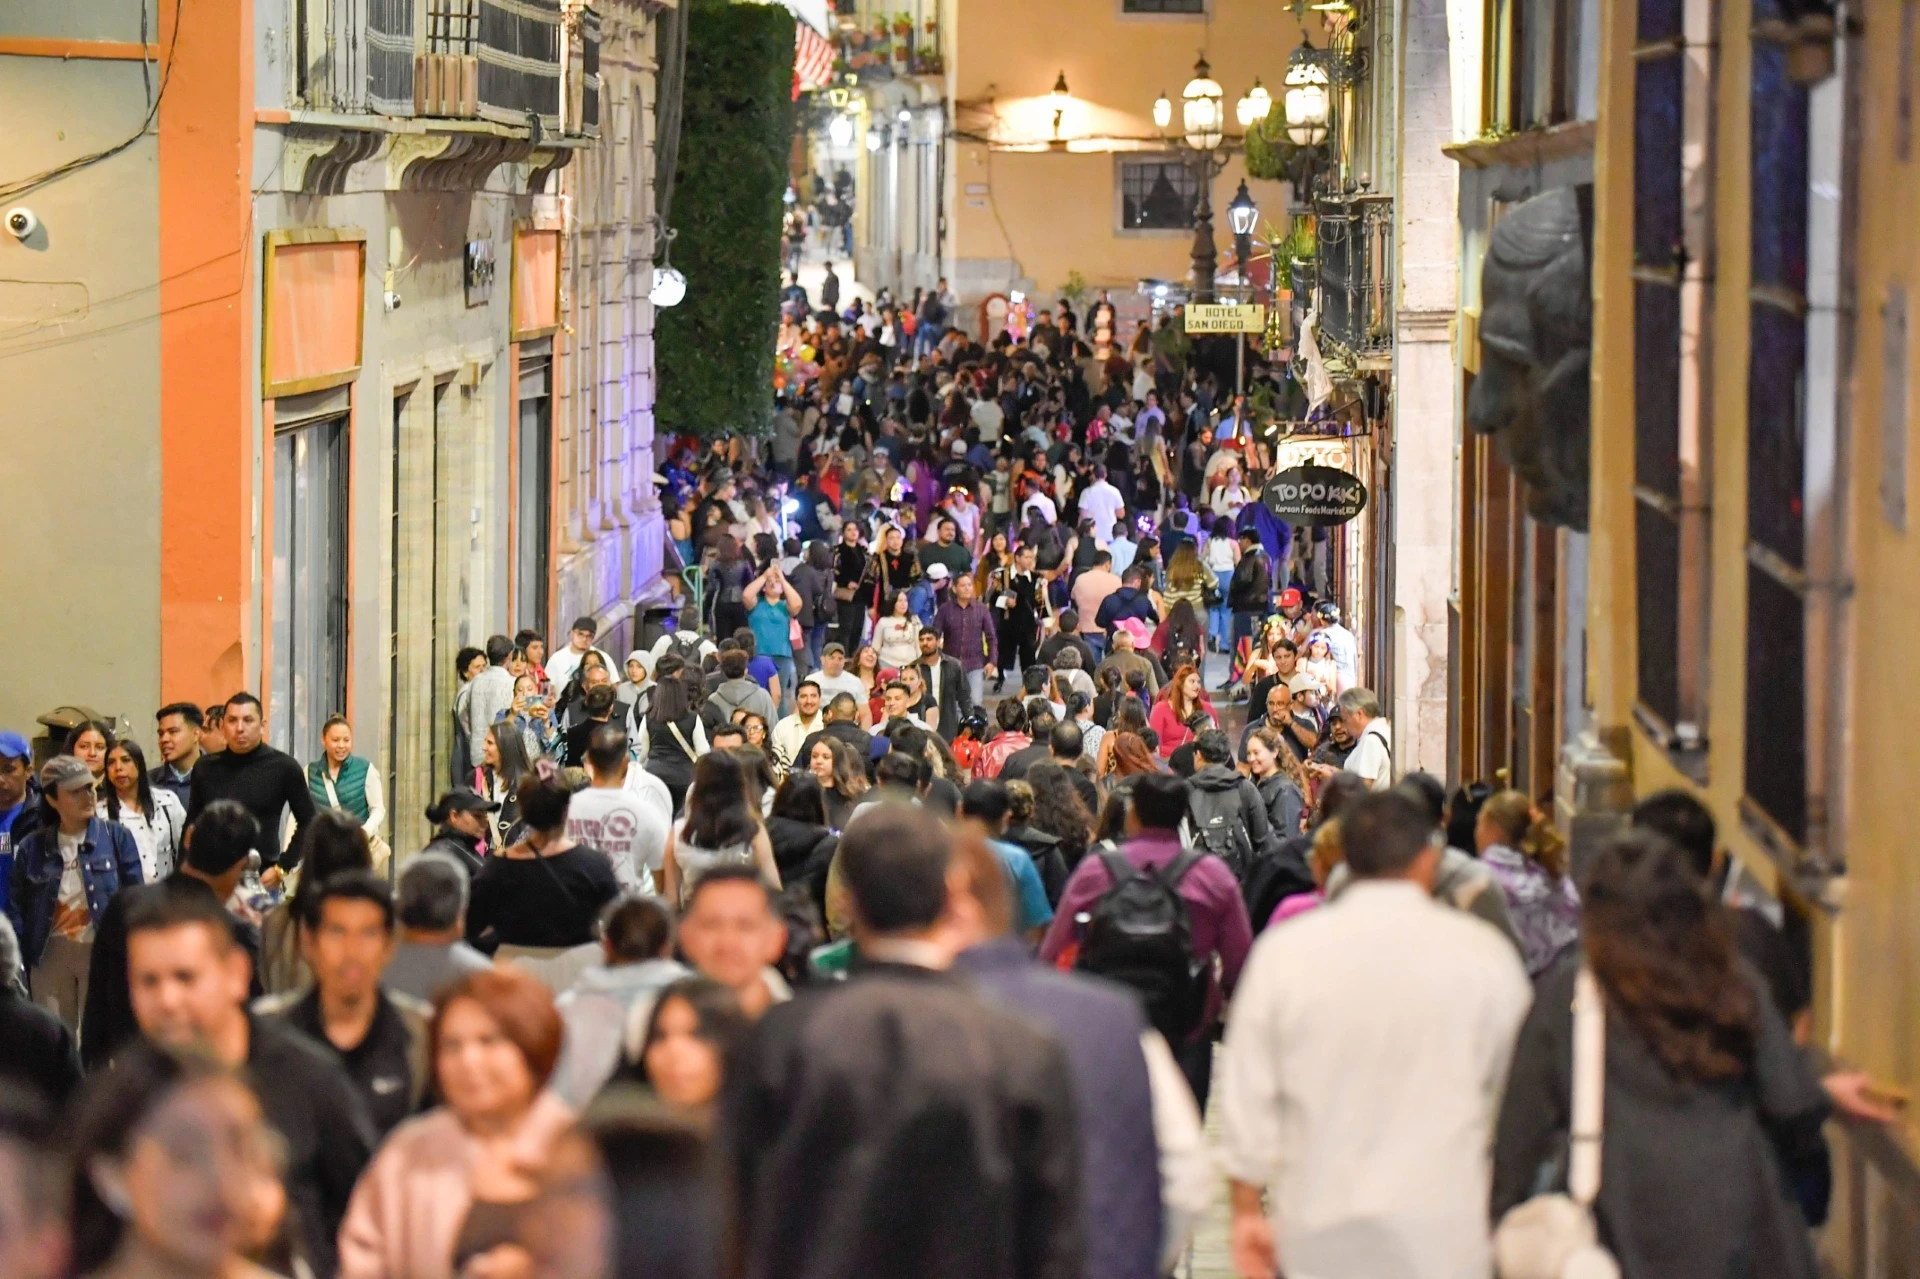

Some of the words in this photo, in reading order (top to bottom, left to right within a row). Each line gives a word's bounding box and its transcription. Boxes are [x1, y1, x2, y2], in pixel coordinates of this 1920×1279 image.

[1205, 307, 1242, 318] HOTEL
[1188, 320, 1209, 329] SAN
[1211, 320, 1244, 330] DIEGO
[1275, 503, 1300, 513] Korean
